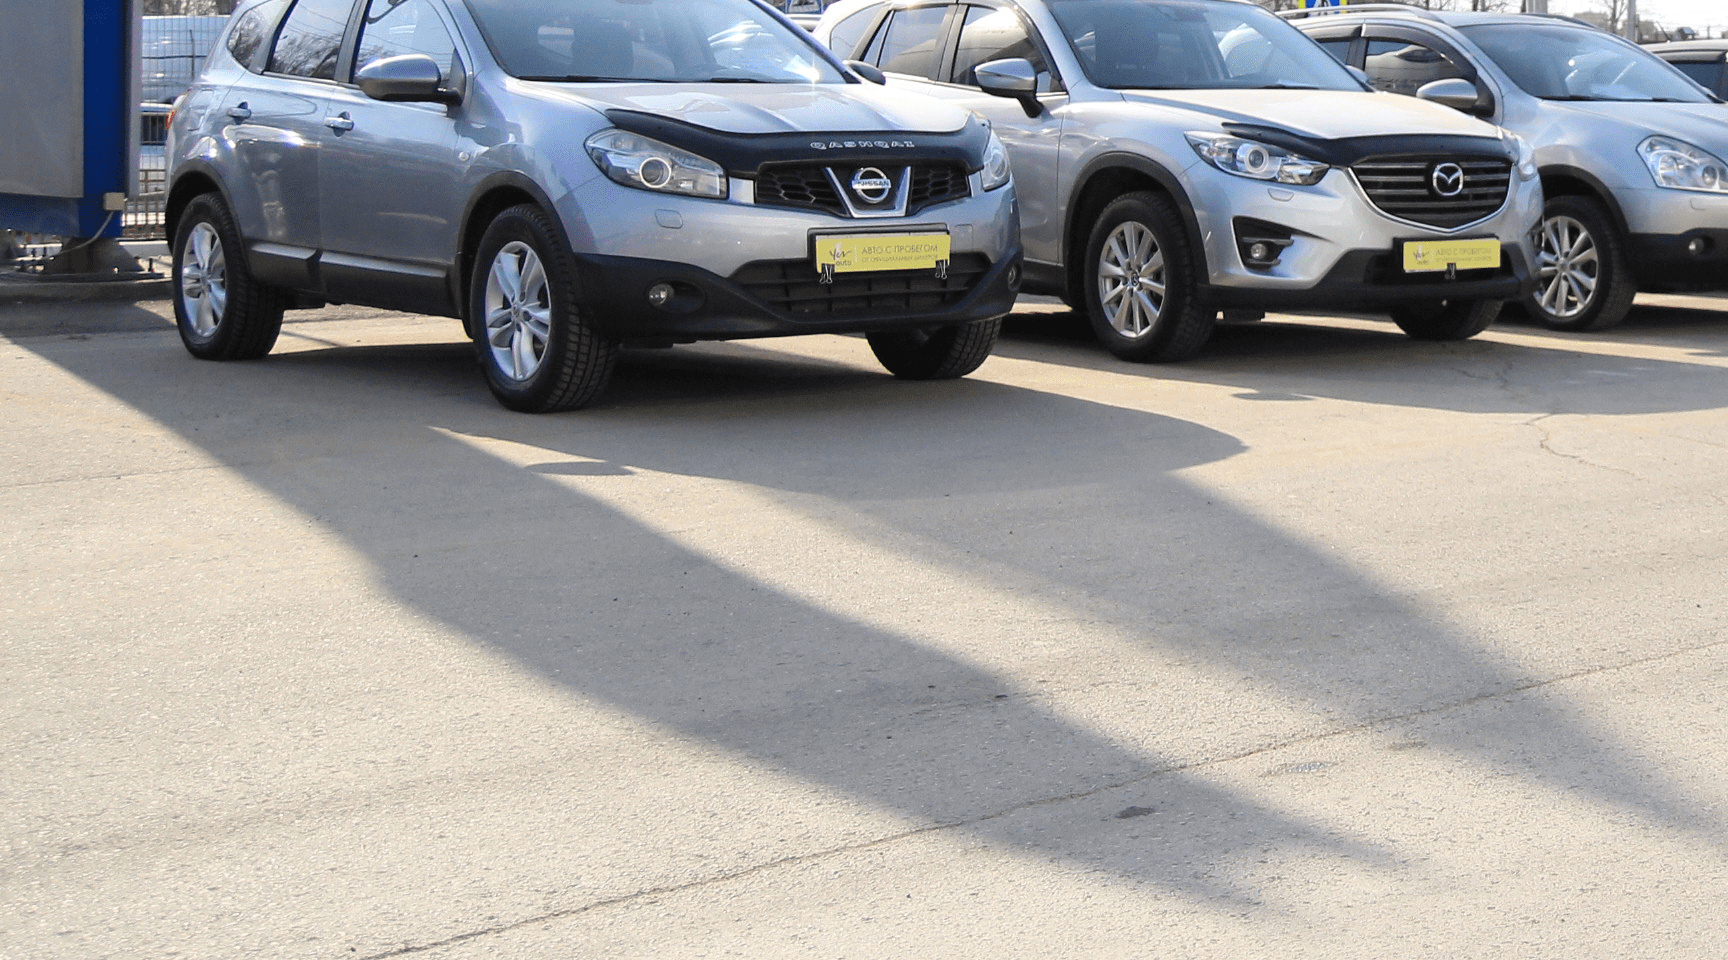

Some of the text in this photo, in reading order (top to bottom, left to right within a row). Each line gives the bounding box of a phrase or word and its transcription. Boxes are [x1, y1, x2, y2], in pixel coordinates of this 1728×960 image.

[810, 141, 915, 150] QASHQAI
[857, 179, 889, 188] NISSAN
[862, 245, 882, 255] АВТО
[894, 243, 938, 253] ПРОБЕГОМ
